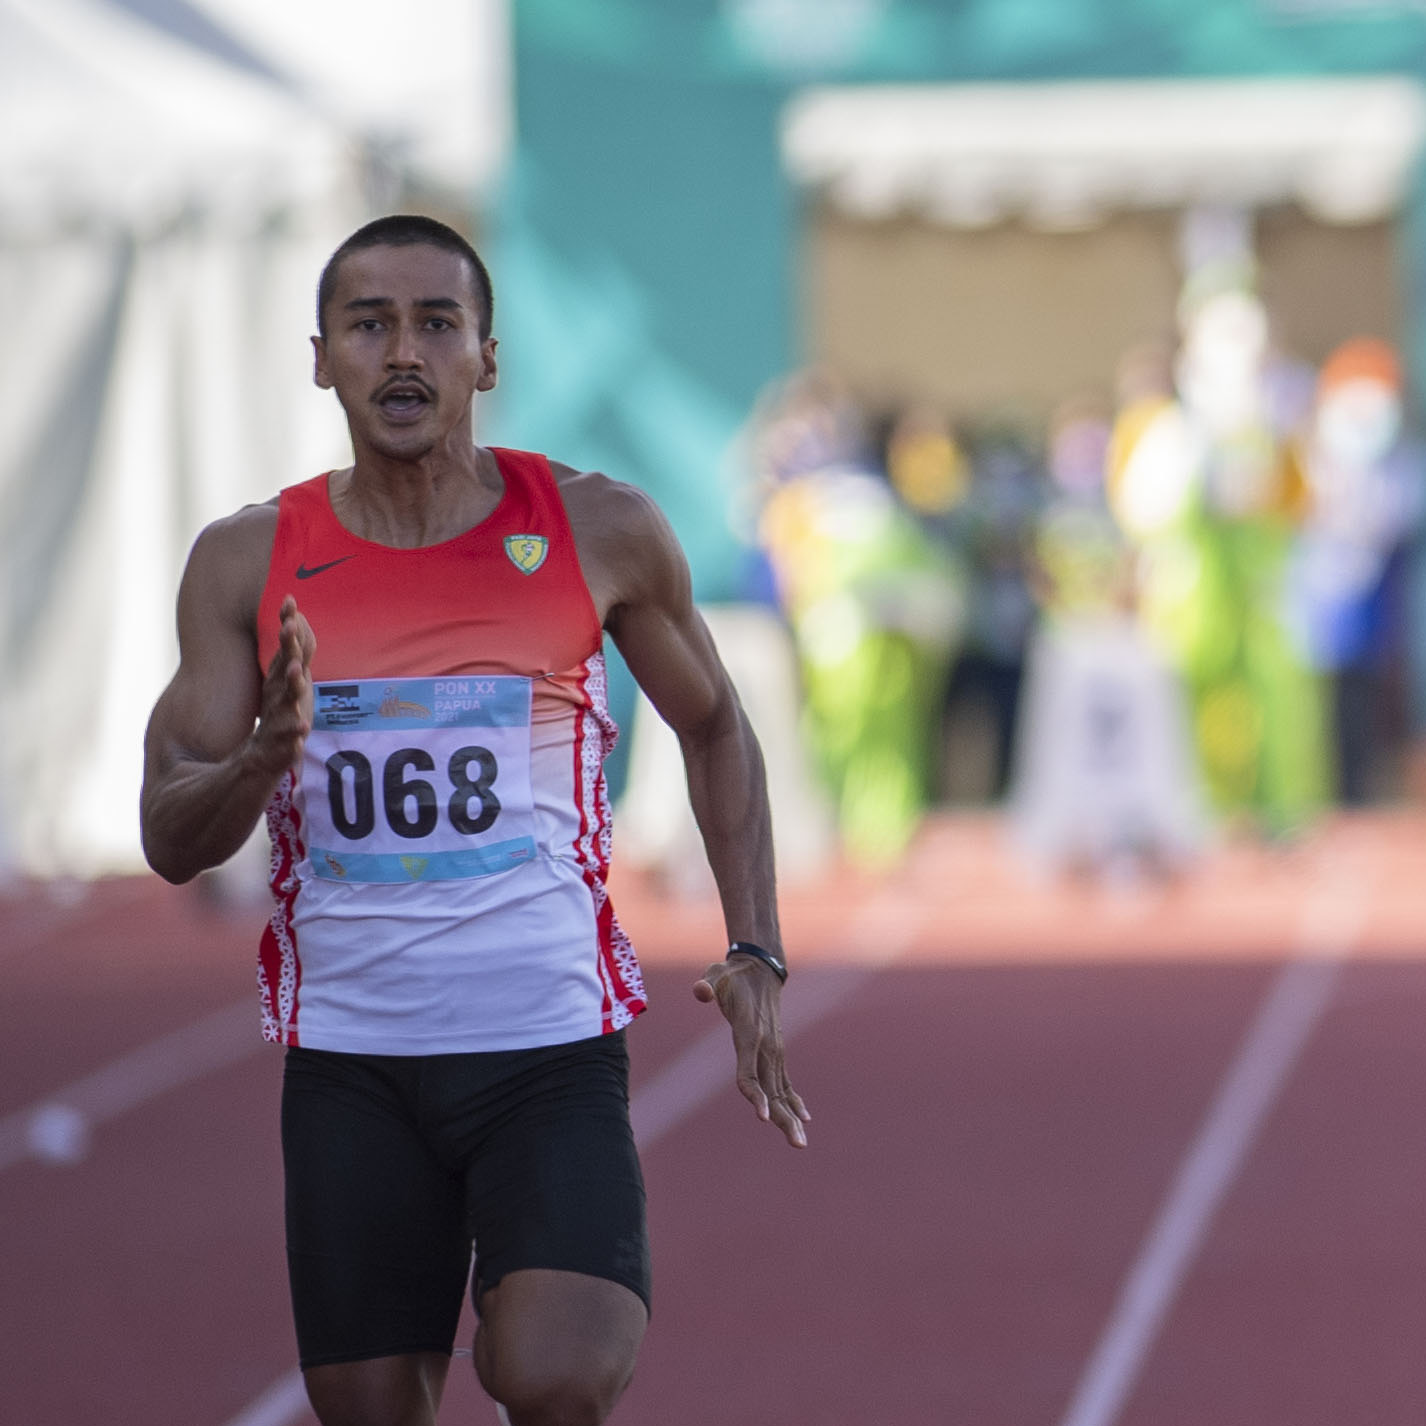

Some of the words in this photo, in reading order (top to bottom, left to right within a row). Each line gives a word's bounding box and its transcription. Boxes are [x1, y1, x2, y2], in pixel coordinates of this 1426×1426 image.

[434, 681, 469, 695] PON
[475, 681, 496, 694] XX
[434, 699, 480, 711] PAPUA
[325, 745, 501, 840] 068
